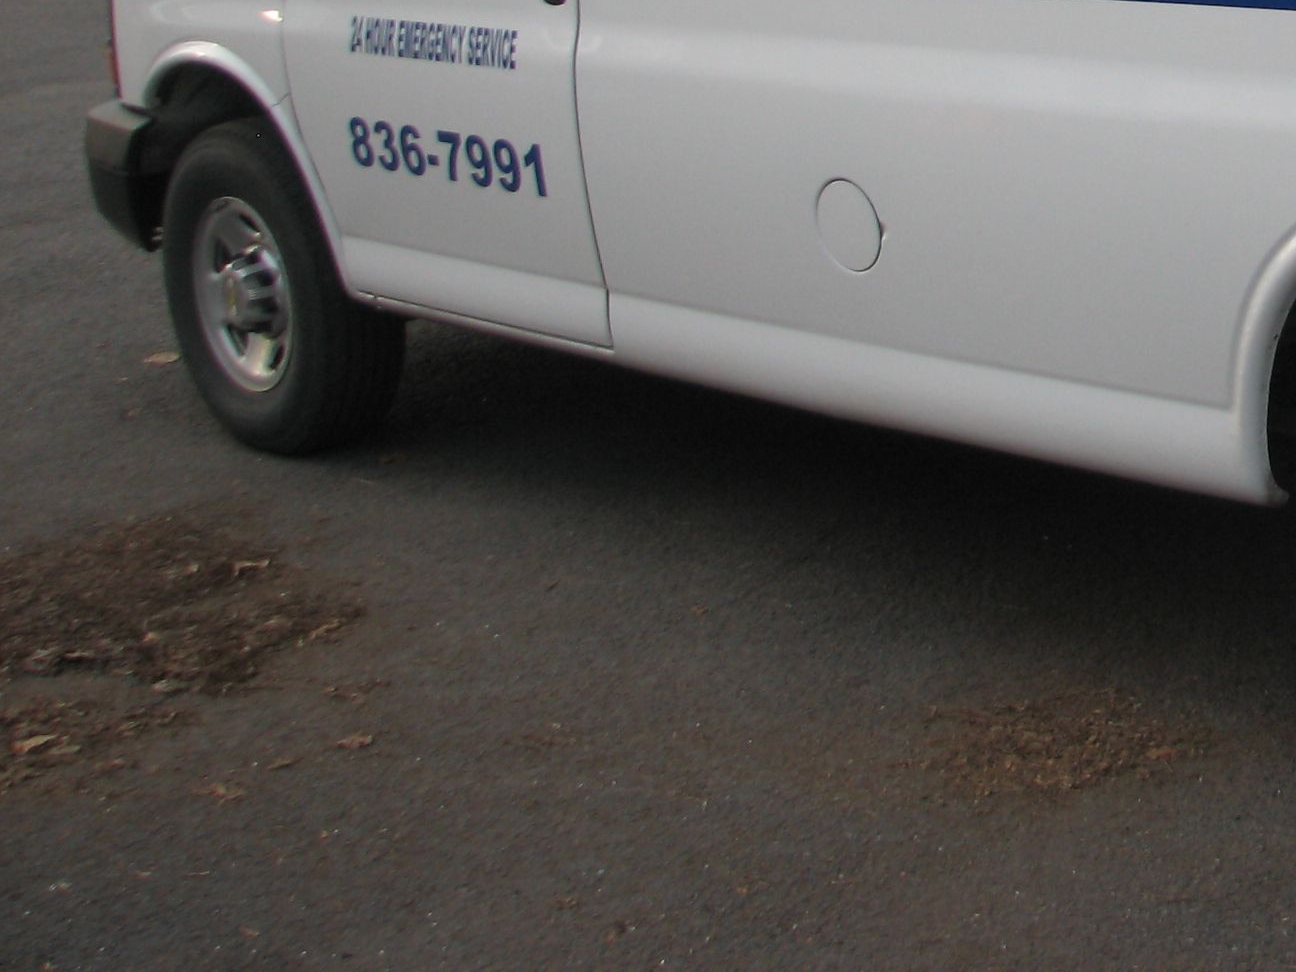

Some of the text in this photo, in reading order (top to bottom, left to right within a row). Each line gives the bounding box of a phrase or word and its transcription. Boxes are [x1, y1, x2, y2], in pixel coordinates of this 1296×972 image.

[365, 17, 397, 57] HOUR
[398, 19, 466, 64] EMERGENCY
[468, 26, 518, 70] SERVICE
[350, 116, 548, 198] 836-7991
